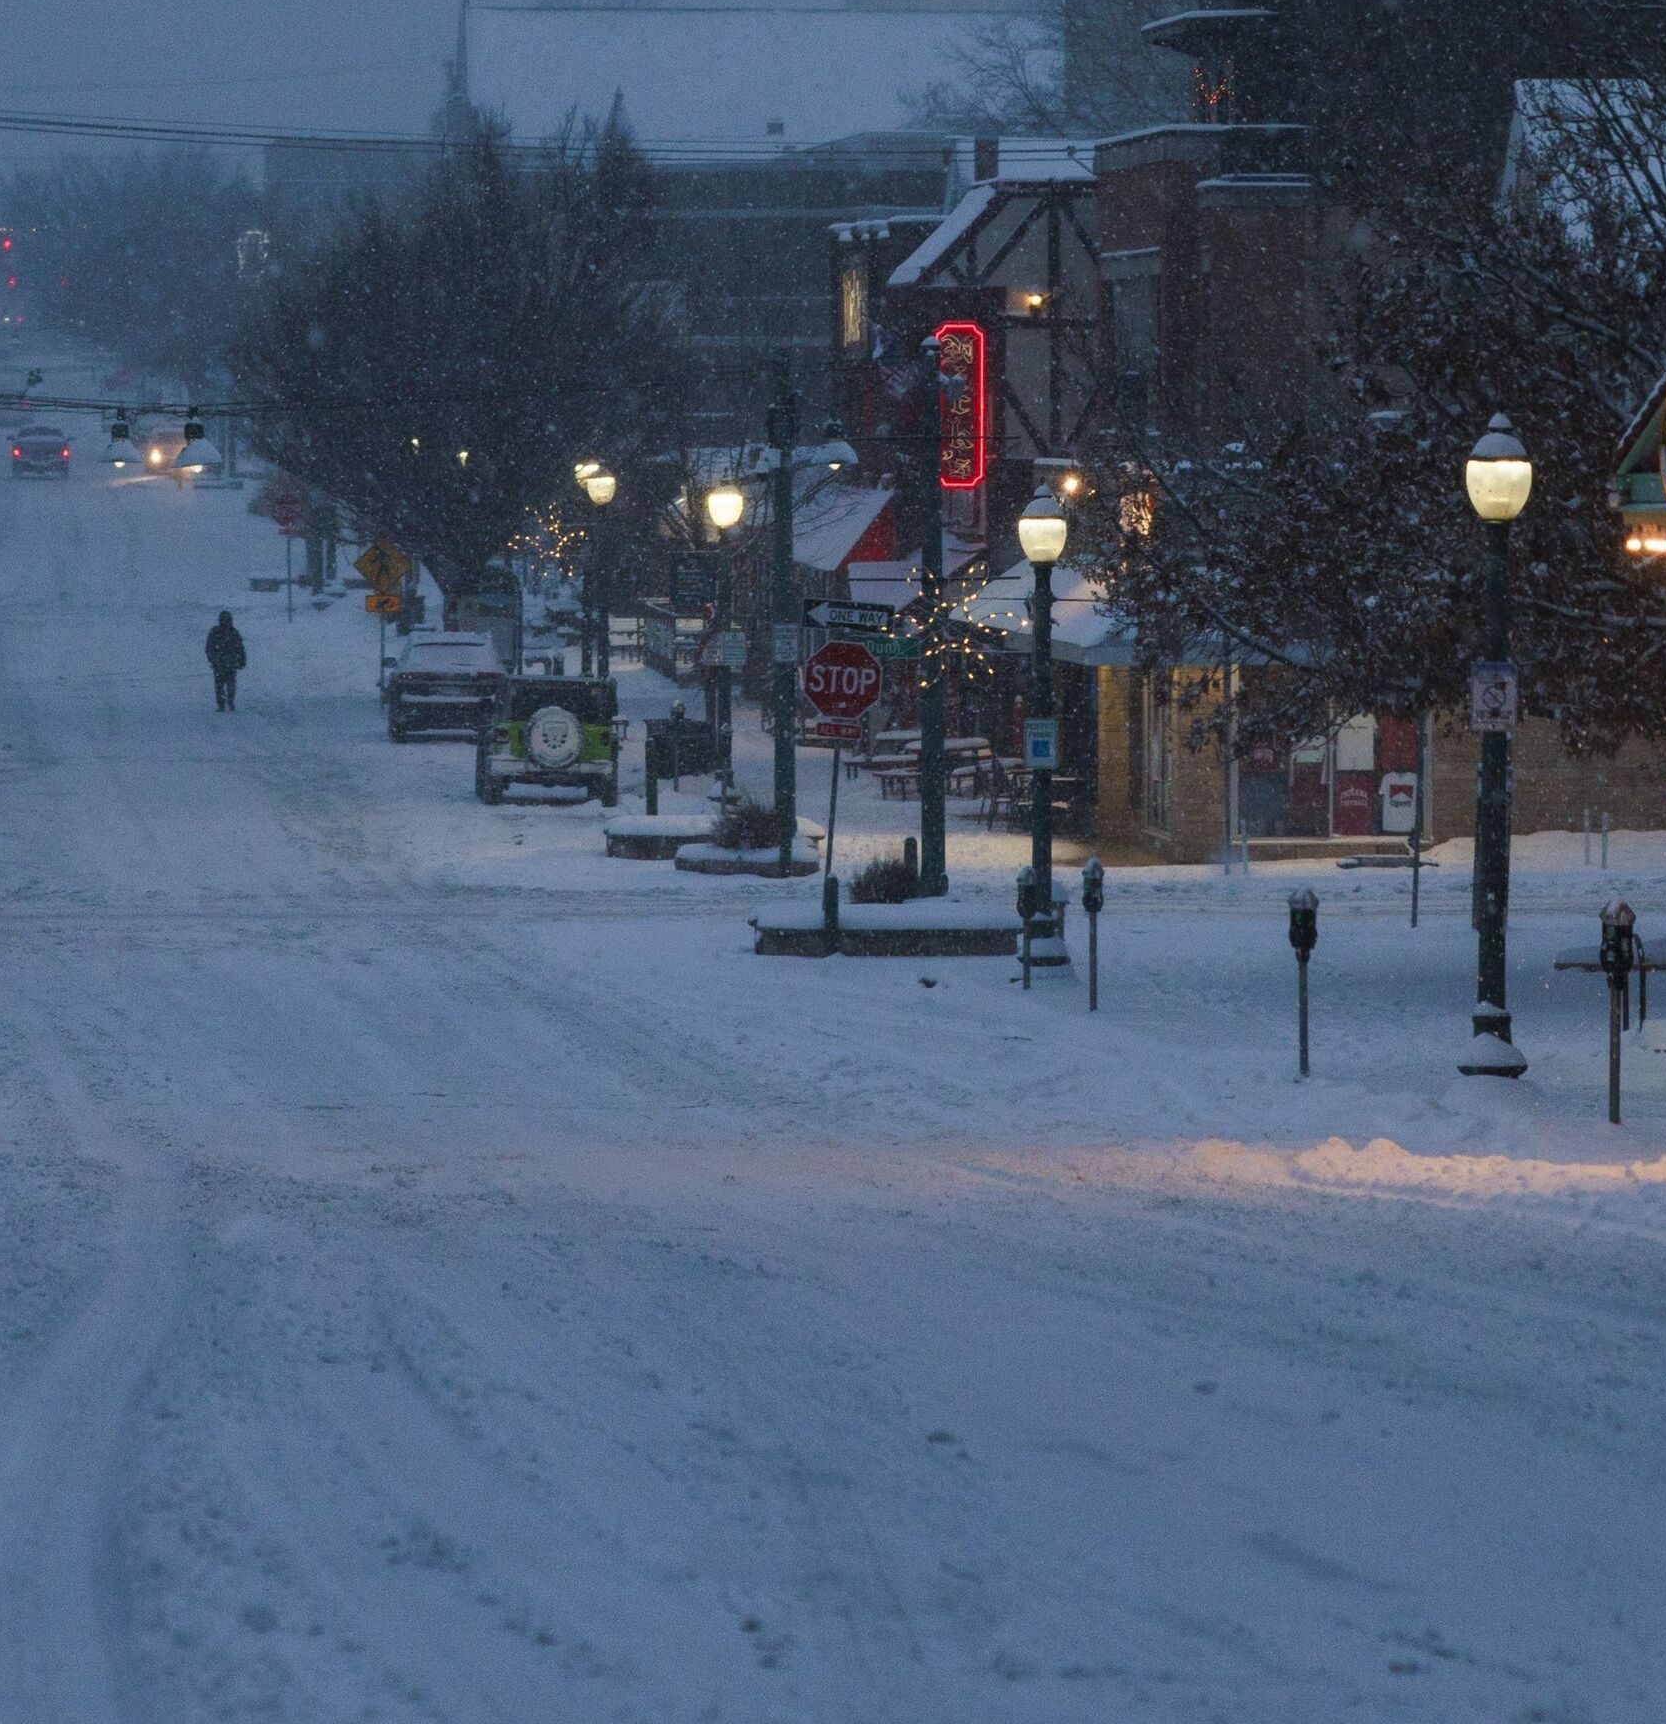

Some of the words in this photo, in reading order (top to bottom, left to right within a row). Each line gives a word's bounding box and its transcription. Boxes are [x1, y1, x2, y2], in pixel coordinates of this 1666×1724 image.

[829, 609, 855, 622] ONE
[858, 611, 883, 624] WAY
[866, 639, 901, 654] Dunn
[809, 664, 877, 696] STOP
